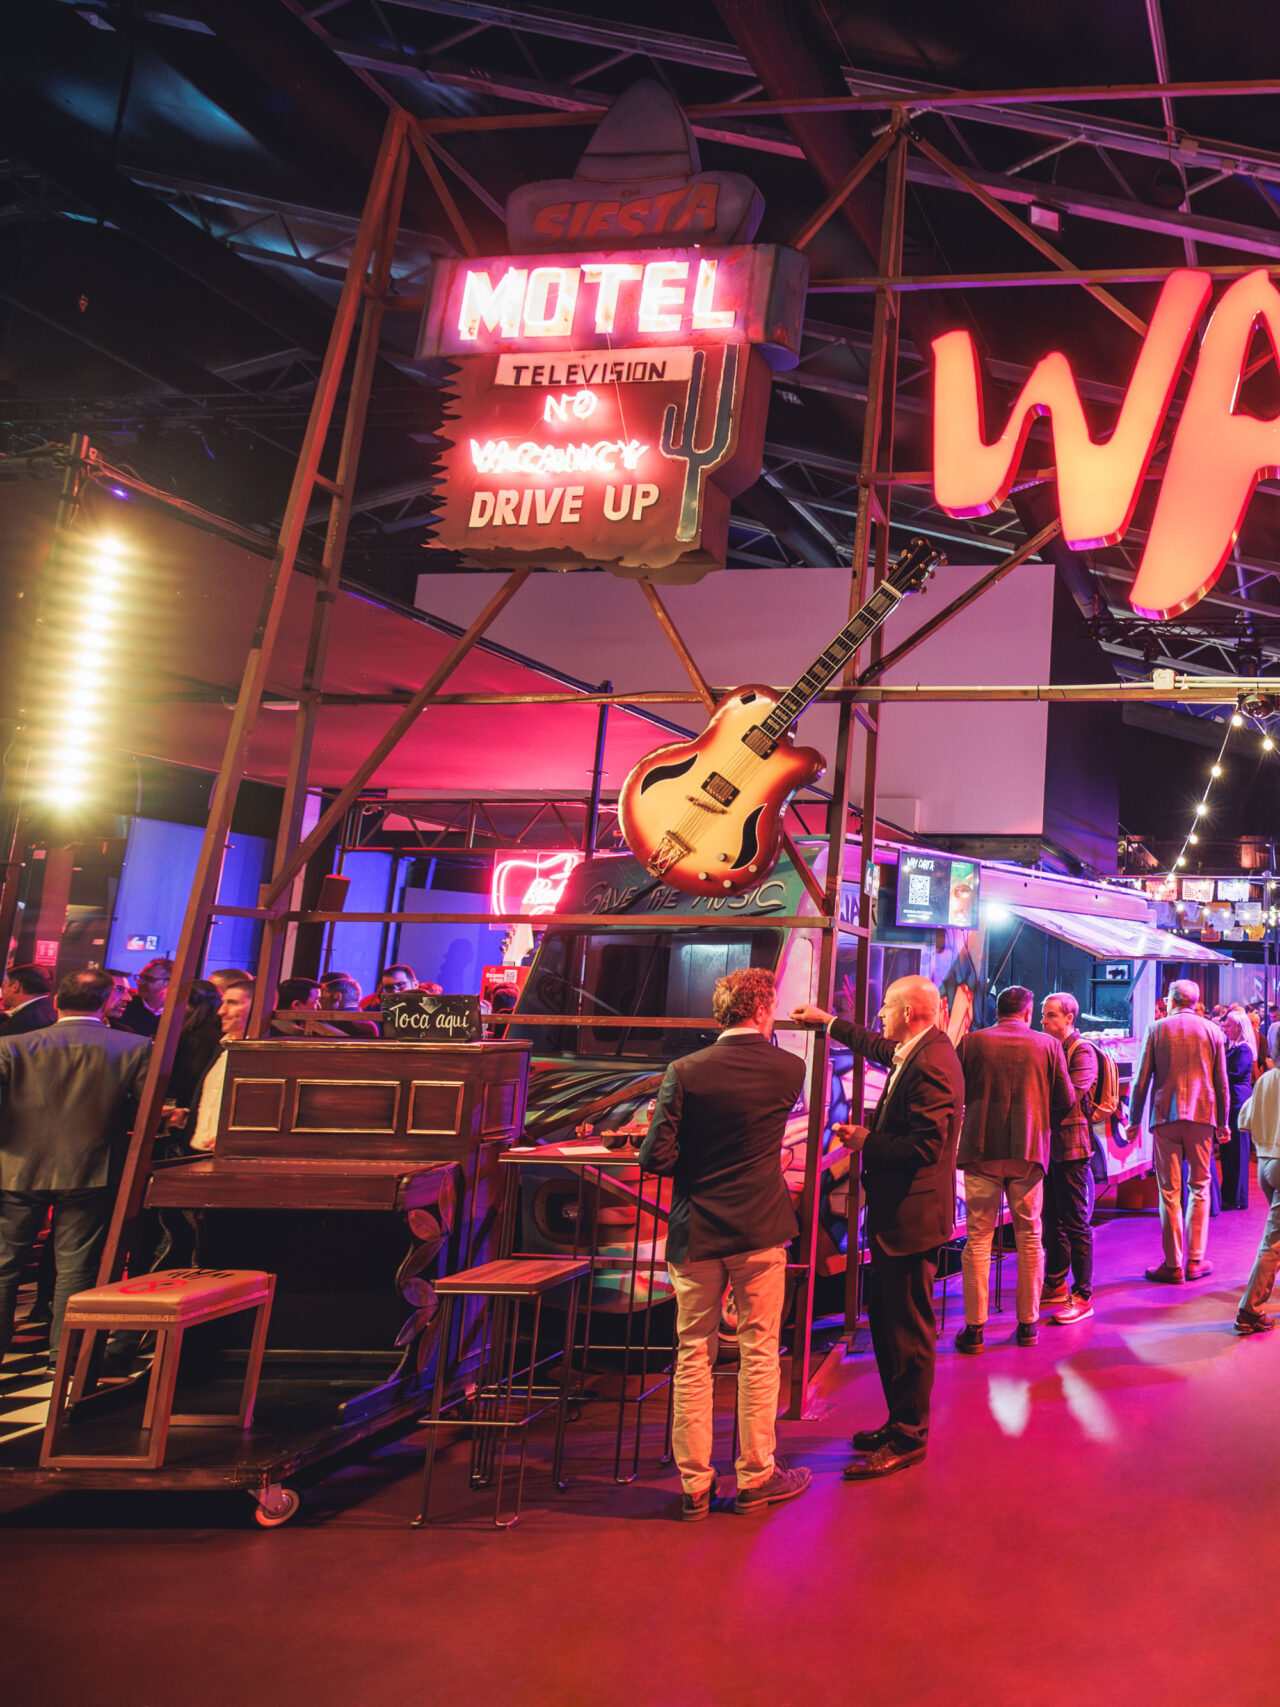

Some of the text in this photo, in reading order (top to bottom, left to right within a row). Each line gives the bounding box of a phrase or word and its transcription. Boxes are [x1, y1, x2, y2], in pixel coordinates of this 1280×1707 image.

[532, 182, 721, 245] SIESTA
[458, 258, 736, 340] MOTEL
[511, 359, 668, 386] TELEVISION
[543, 389, 598, 423] NO
[469, 438, 650, 476] VACANCY
[468, 482, 662, 529] DRIVE UP
[584, 880, 638, 915] SAVE
[645, 884, 680, 911] THE
[388, 1001, 470, 1038] Toca aquí
